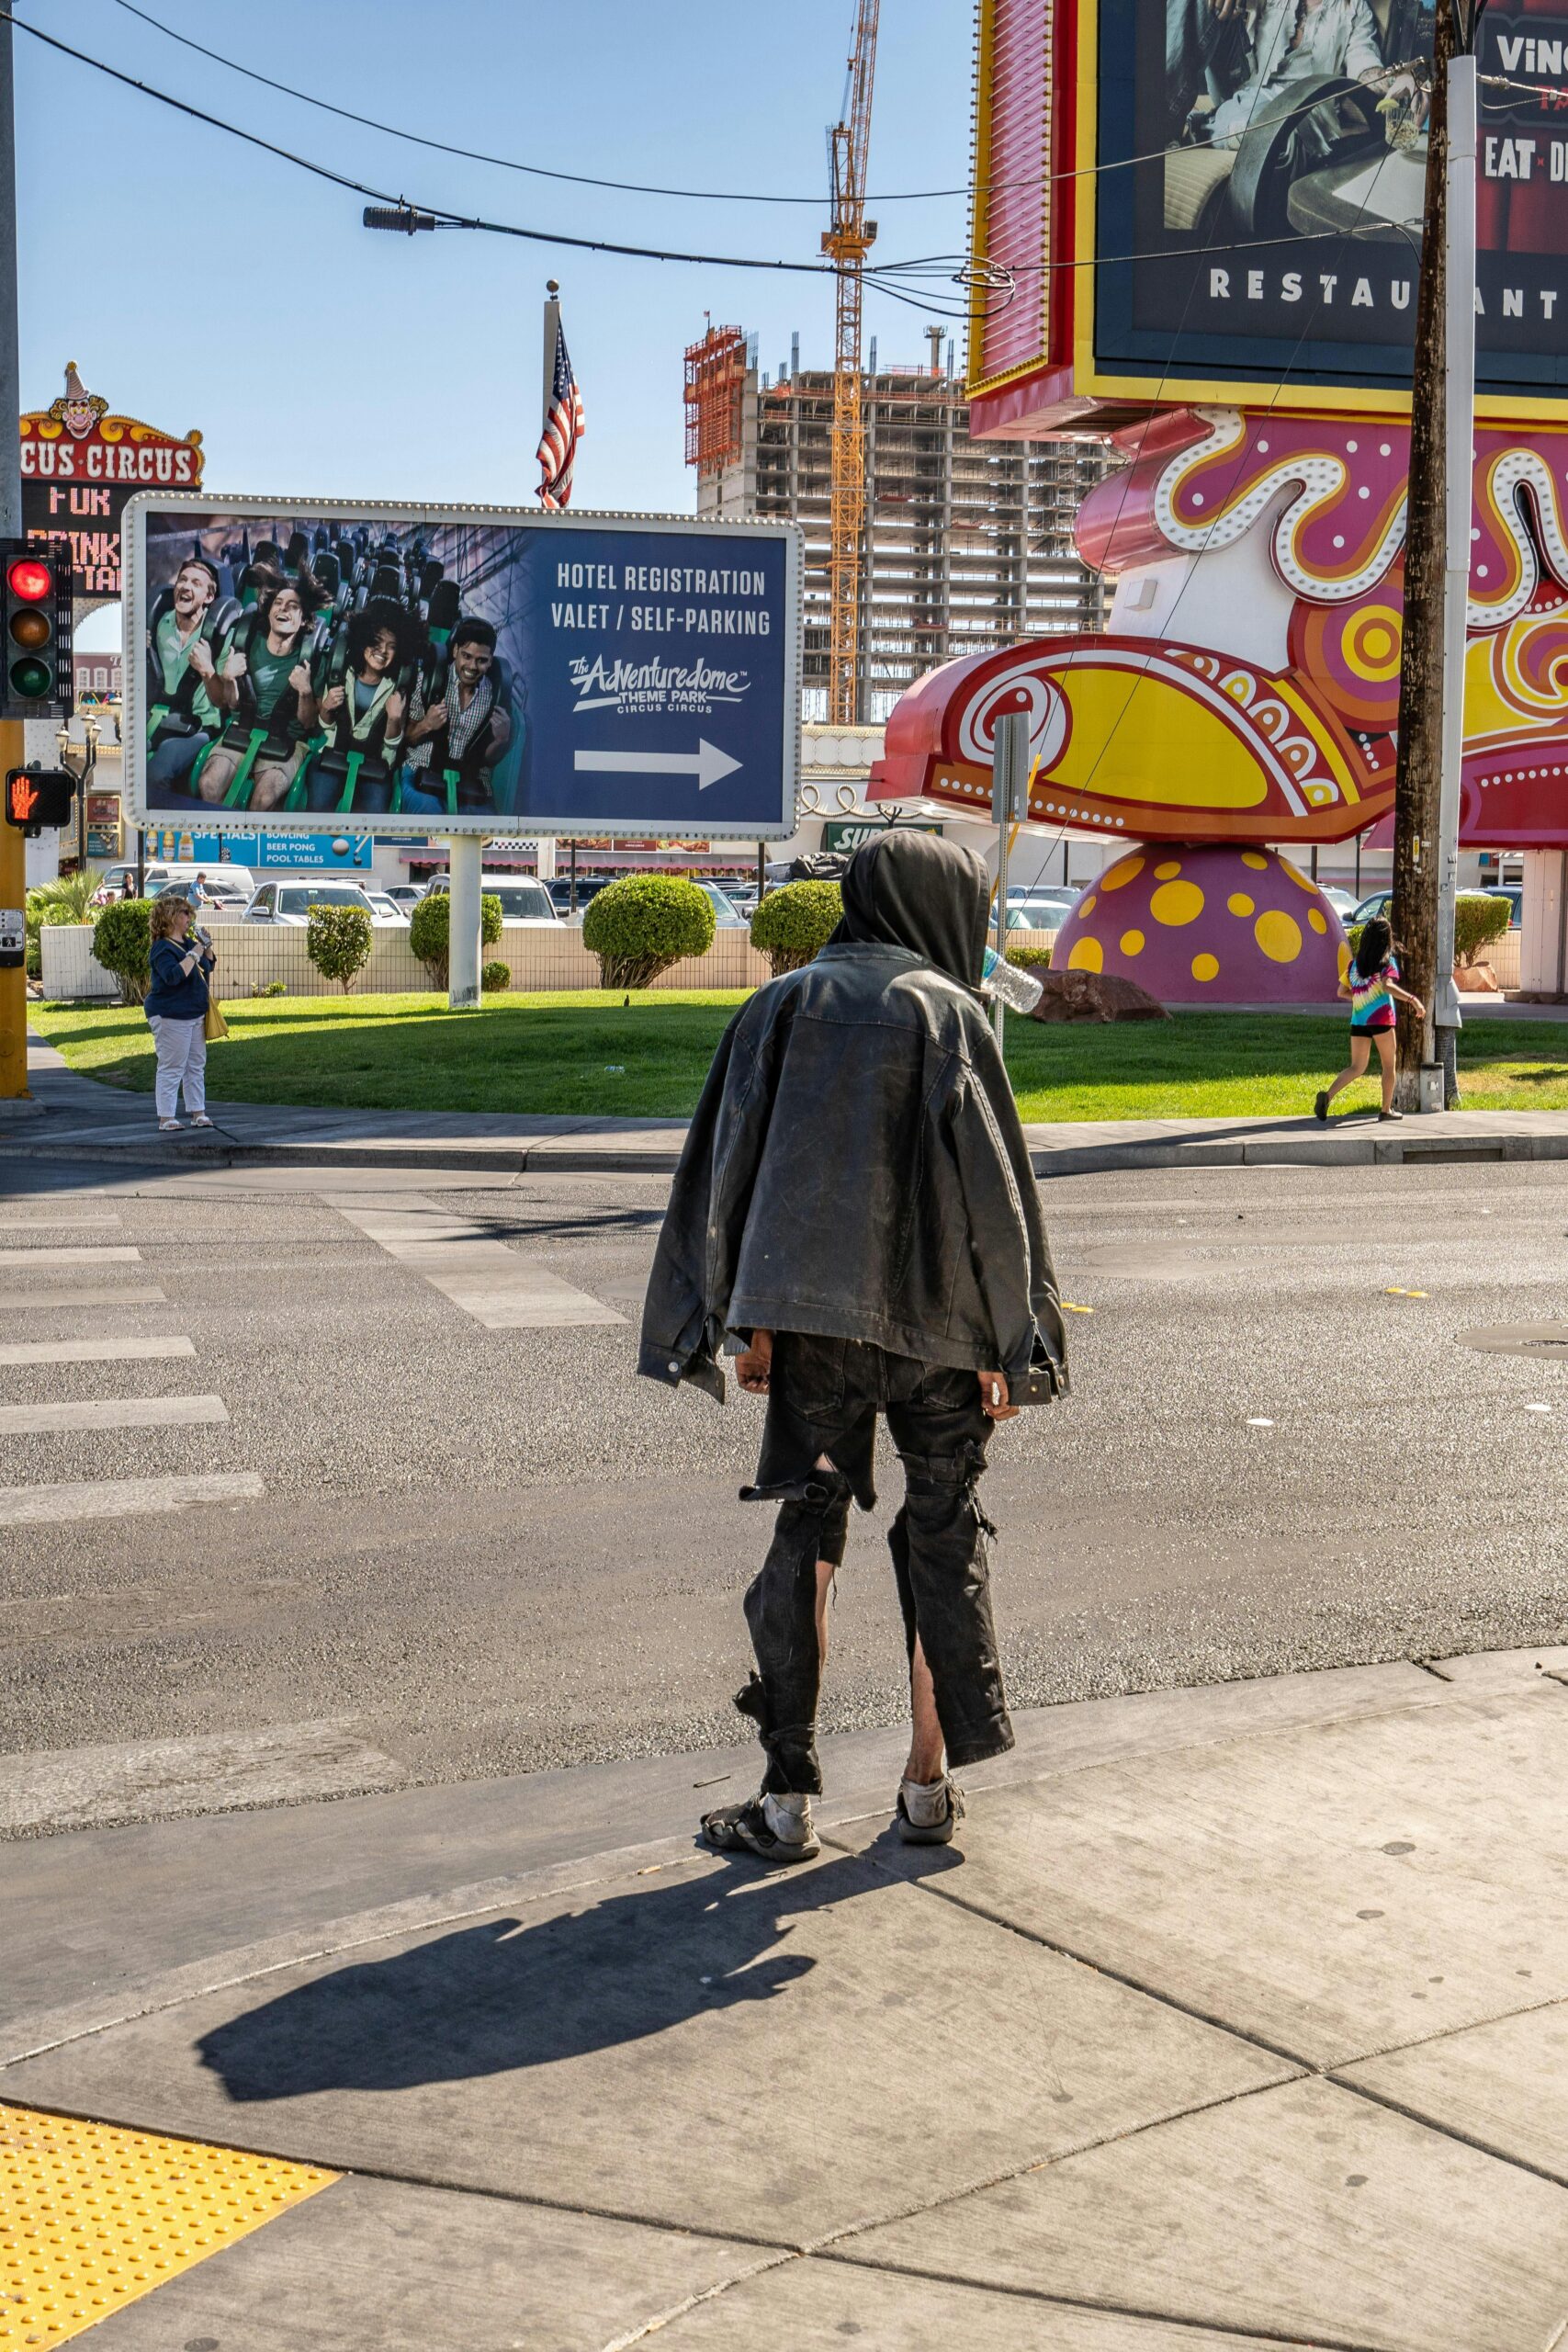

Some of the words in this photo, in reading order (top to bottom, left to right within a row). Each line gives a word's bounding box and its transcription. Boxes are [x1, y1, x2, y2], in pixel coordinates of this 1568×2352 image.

[1485, 136, 1536, 179] EAT
[1210, 267, 1557, 320] RESTAUNT
[86, 445, 192, 482] CIRCUS
[558, 562, 616, 590] HOTEL
[625, 566, 765, 595] REGISTRATION
[551, 603, 609, 629] VALET
[631, 606, 771, 635] SELF-PARKING
[569, 656, 589, 674] The
[570, 653, 751, 695] Adventuredome
[617, 705, 662, 714] CIRCUS
[668, 704, 712, 714] CIRCUS
[619, 691, 667, 704] THEME
[671, 691, 707, 704] PARK
[266, 842, 288, 851] BEER
[289, 843, 316, 852] PONG
[266, 854, 291, 863] POOL
[293, 855, 324, 864] TABLES
